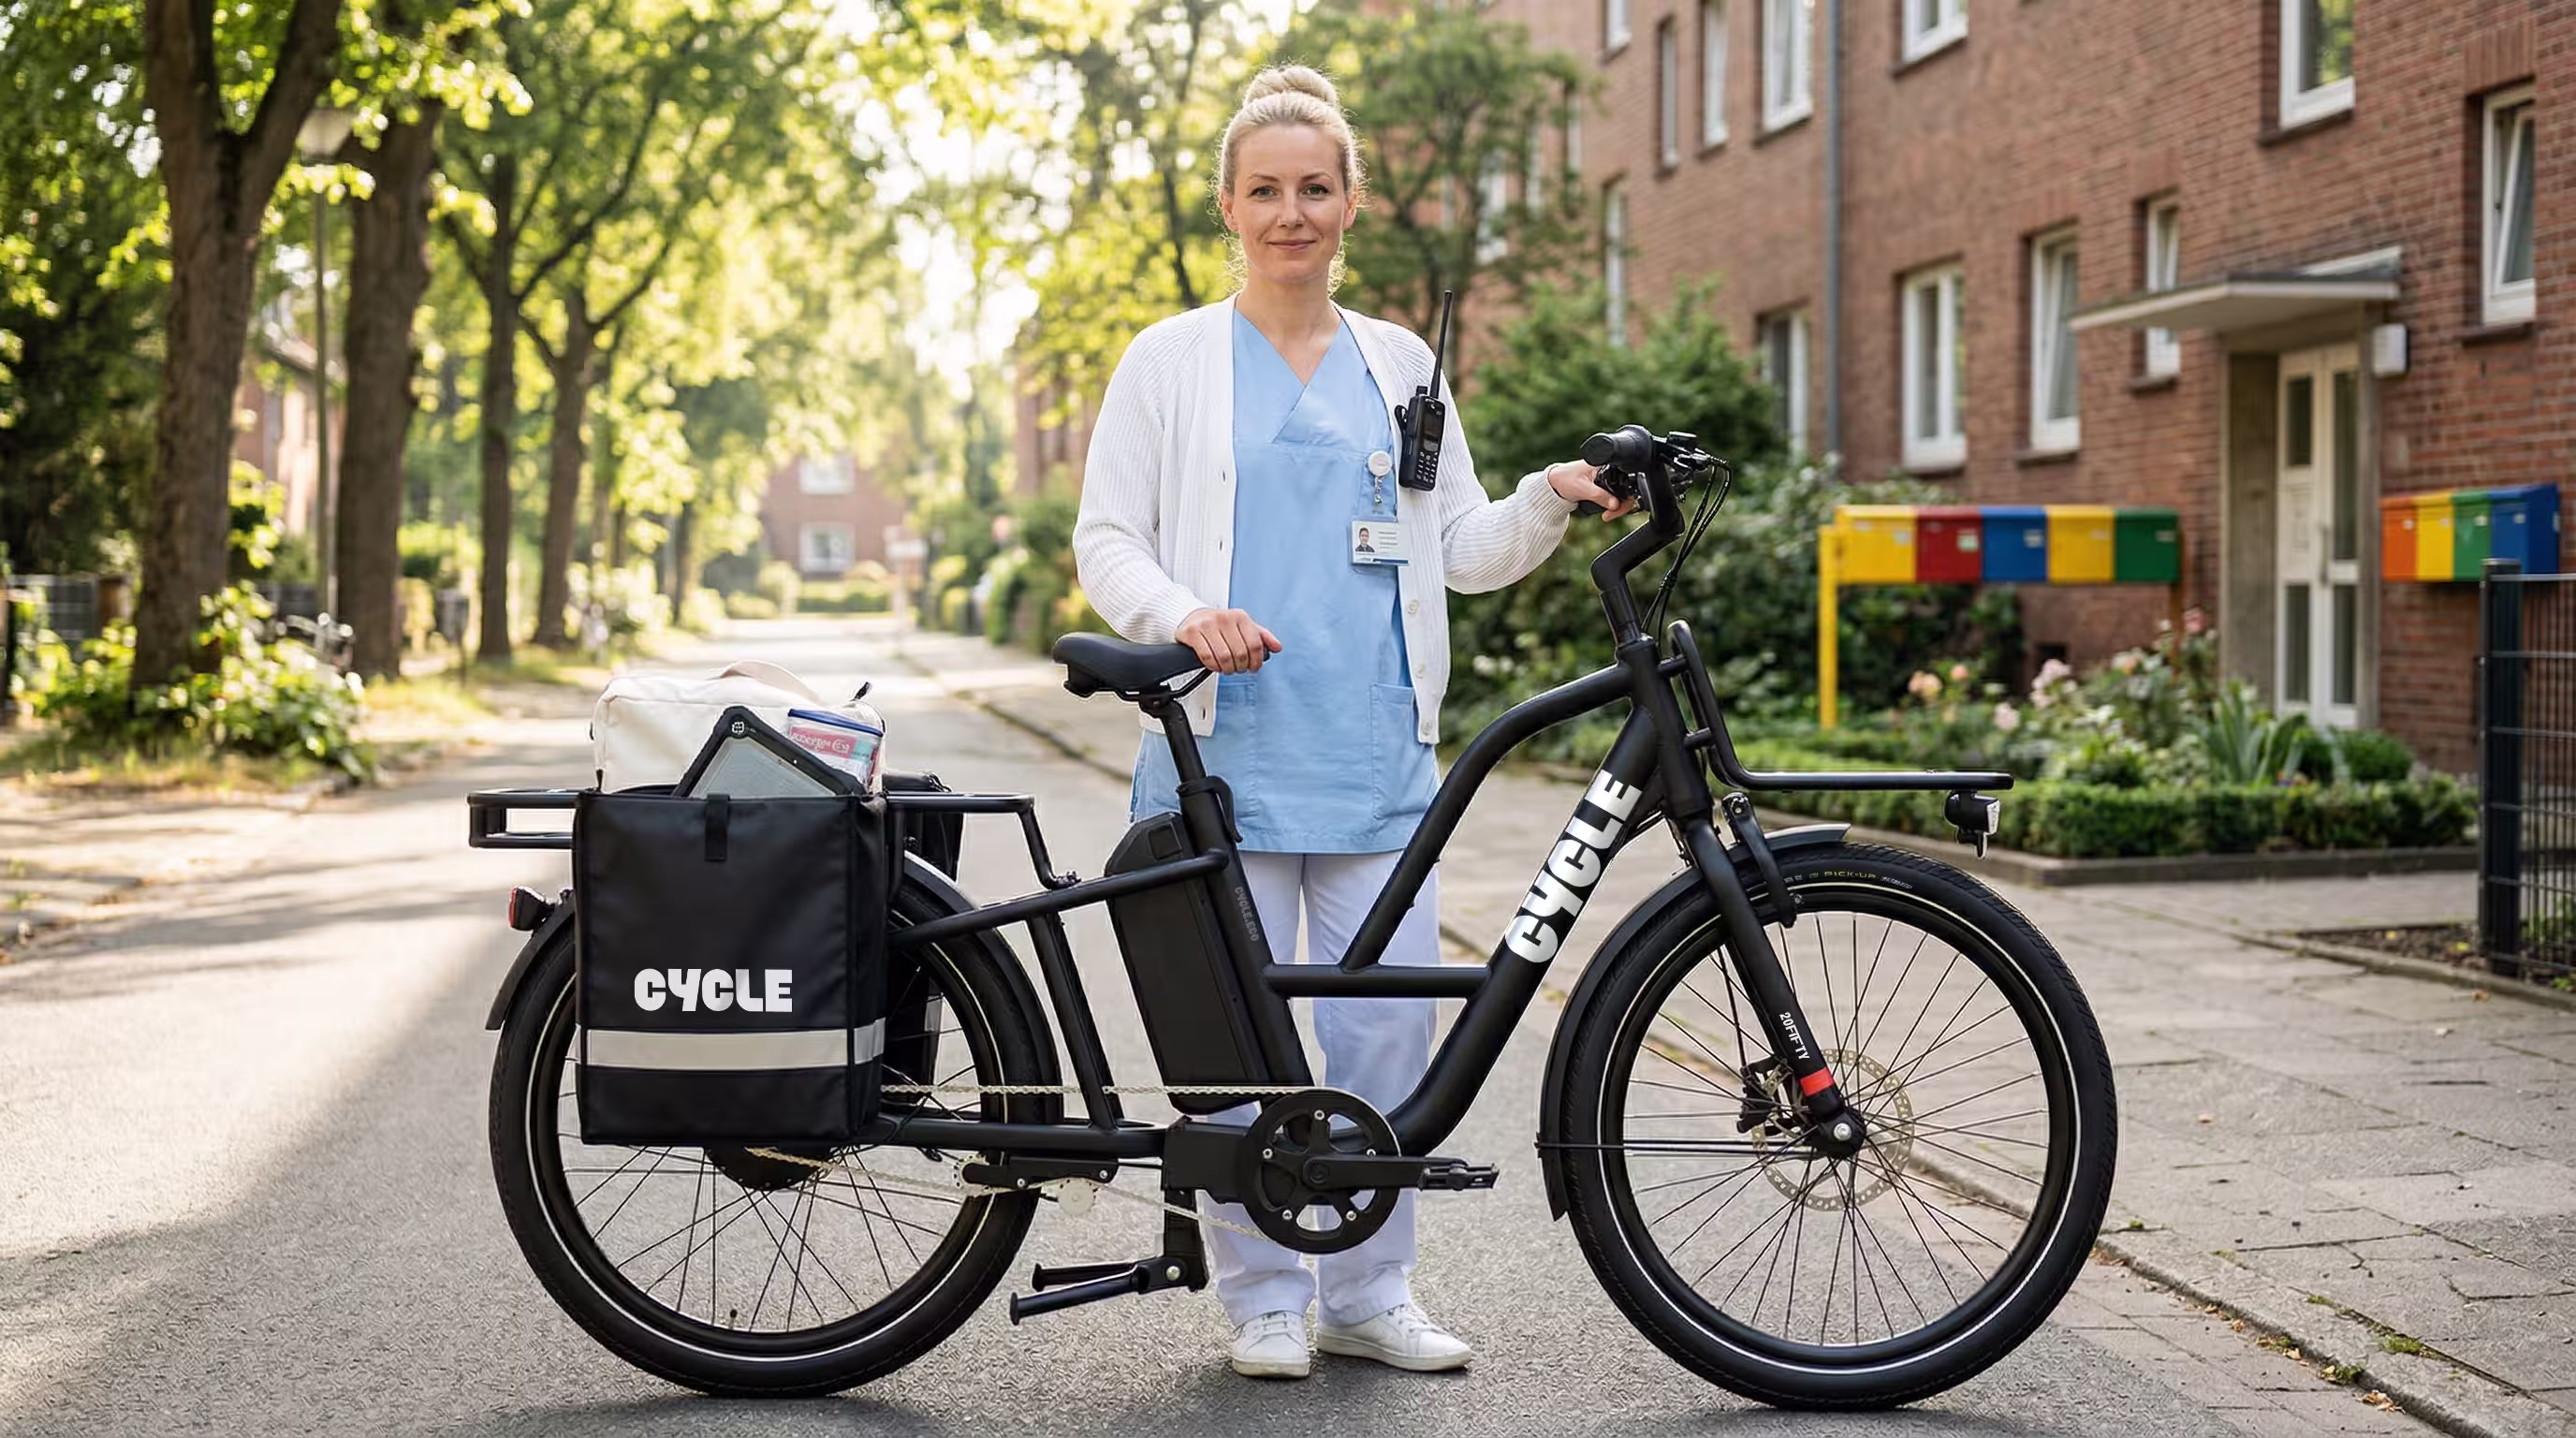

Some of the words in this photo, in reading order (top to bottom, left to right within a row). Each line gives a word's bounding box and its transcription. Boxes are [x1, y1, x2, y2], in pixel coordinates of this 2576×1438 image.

[1505, 769, 1643, 963] CYCLE
[1824, 870, 1878, 879] PICK-UP
[1235, 886, 1260, 942] CYCLE.ECO
[634, 968, 793, 1012] CYCLE
[1778, 1011, 1810, 1060] 20FIFTY
